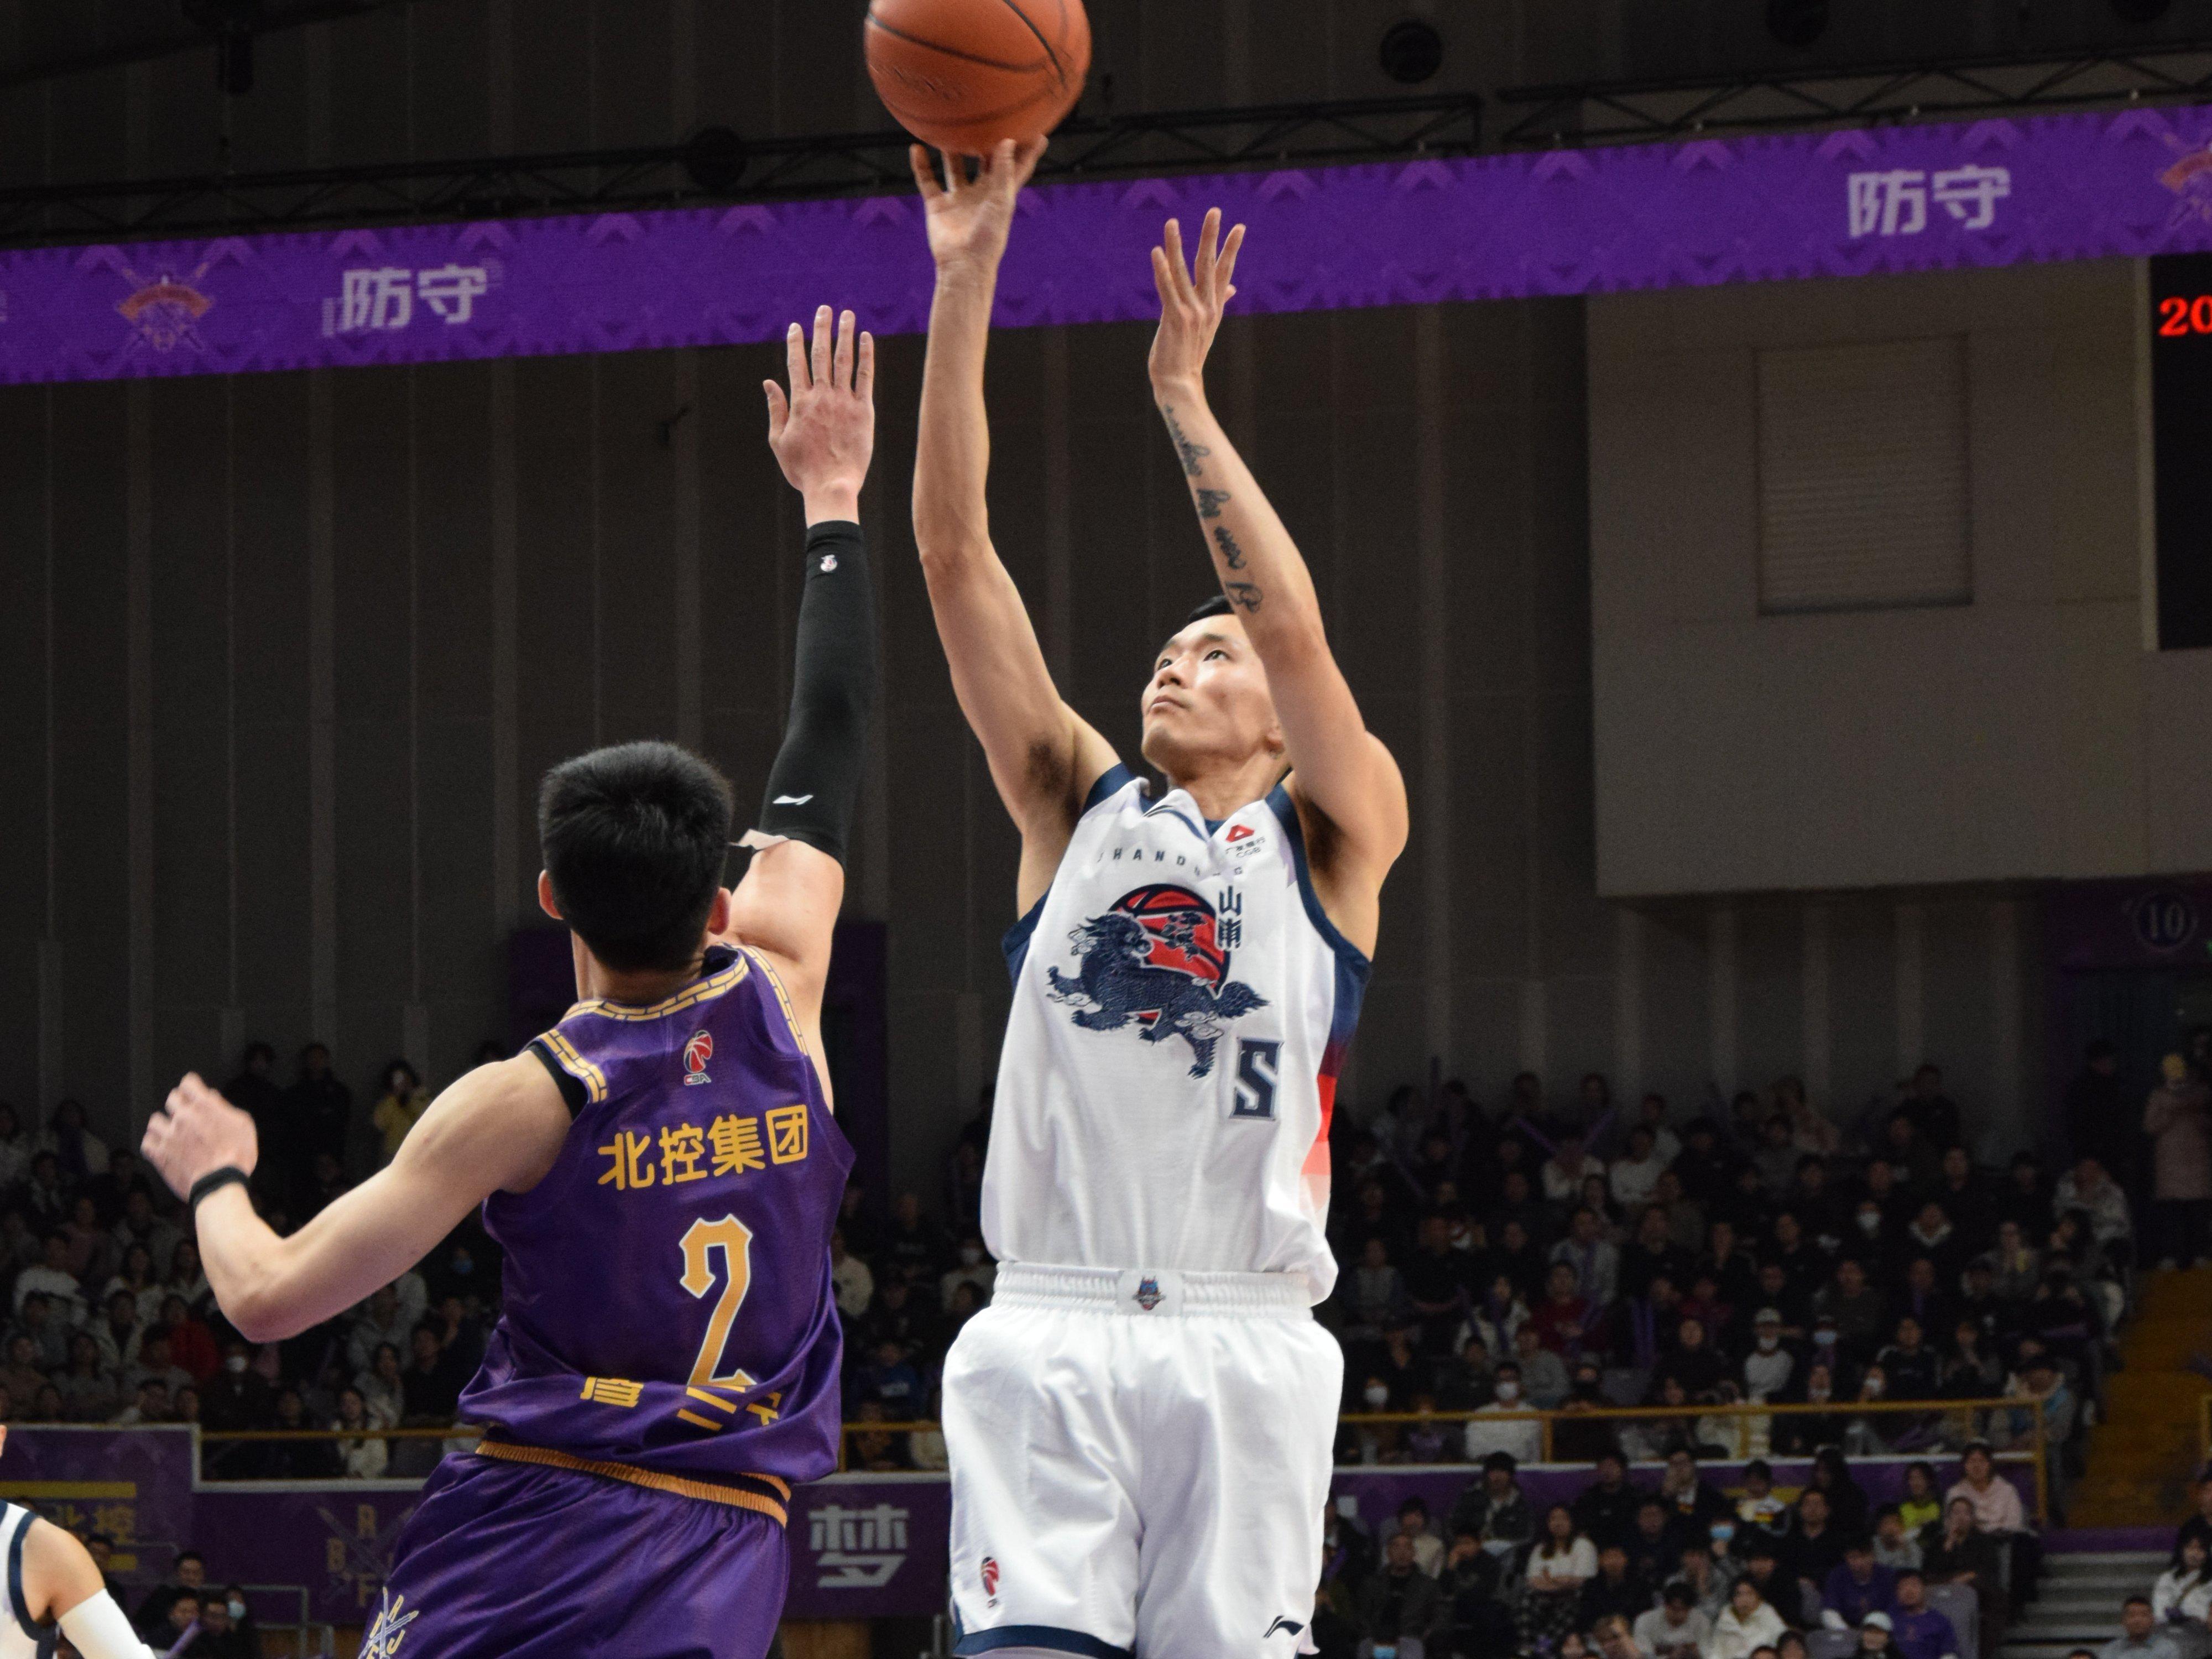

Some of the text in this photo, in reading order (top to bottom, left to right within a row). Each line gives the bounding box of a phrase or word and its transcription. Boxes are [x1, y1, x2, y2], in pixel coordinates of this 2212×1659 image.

[1848, 164, 2011, 238] 防守
[342, 262, 487, 331] 防守
[684, 1072, 712, 1086] CBA
[597, 1104, 808, 1191] 北控集团
[679, 1213, 758, 1386] 2
[807, 1503, 909, 1589] 梦
